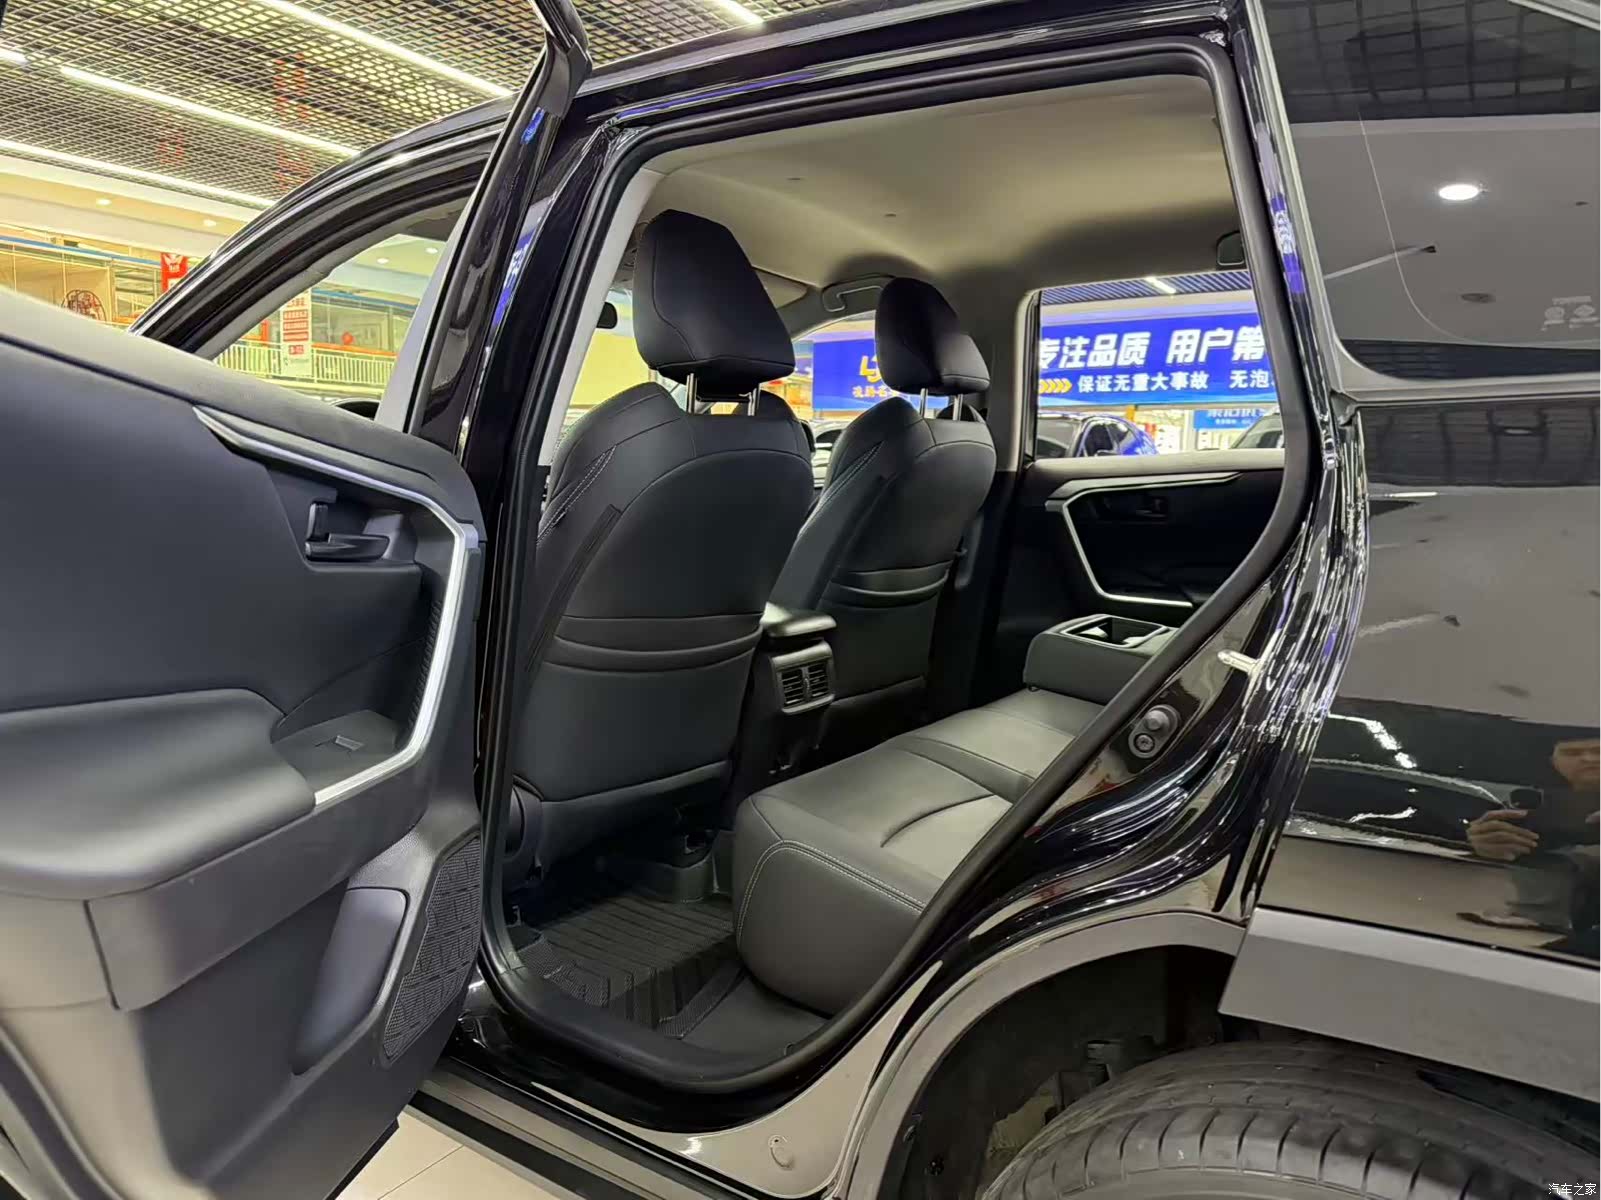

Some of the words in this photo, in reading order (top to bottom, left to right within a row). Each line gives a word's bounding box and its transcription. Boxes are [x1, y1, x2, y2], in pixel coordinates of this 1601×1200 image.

[1078, 370, 1209, 393] 保证无重大事故
[1229, 369, 1275, 389] 无泡
